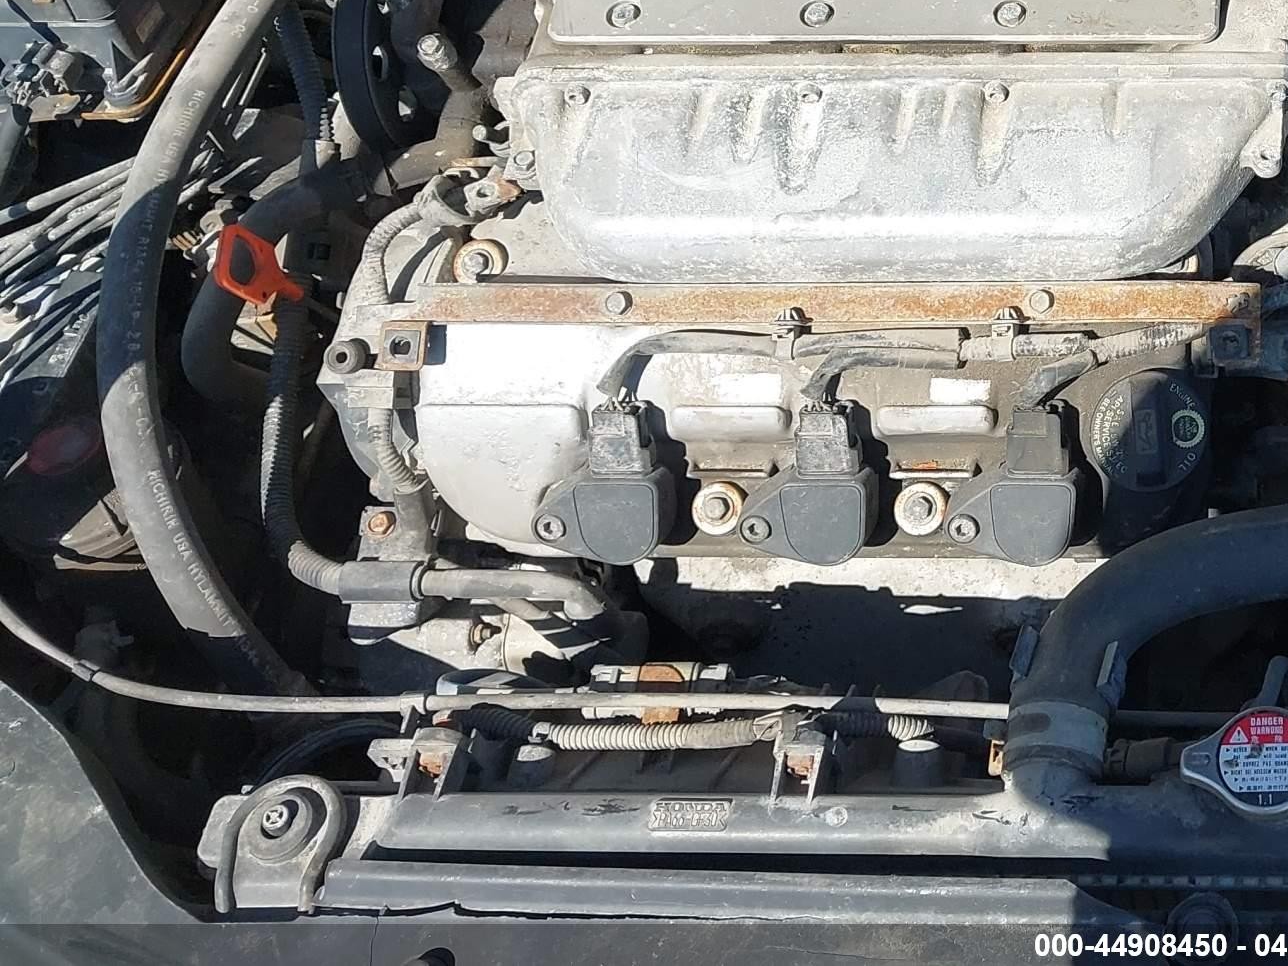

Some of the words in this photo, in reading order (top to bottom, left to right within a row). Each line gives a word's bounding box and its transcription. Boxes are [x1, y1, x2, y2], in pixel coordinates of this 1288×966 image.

[1169, 383, 1197, 410] ENGINE
[1101, 410, 1114, 448] SERVICE
[1178, 452, 1197, 471] OIL
[1250, 717, 1284, 726] DANGER
[1257, 793, 1273, 805] 1.1
[655, 803, 727, 812] HONDA
